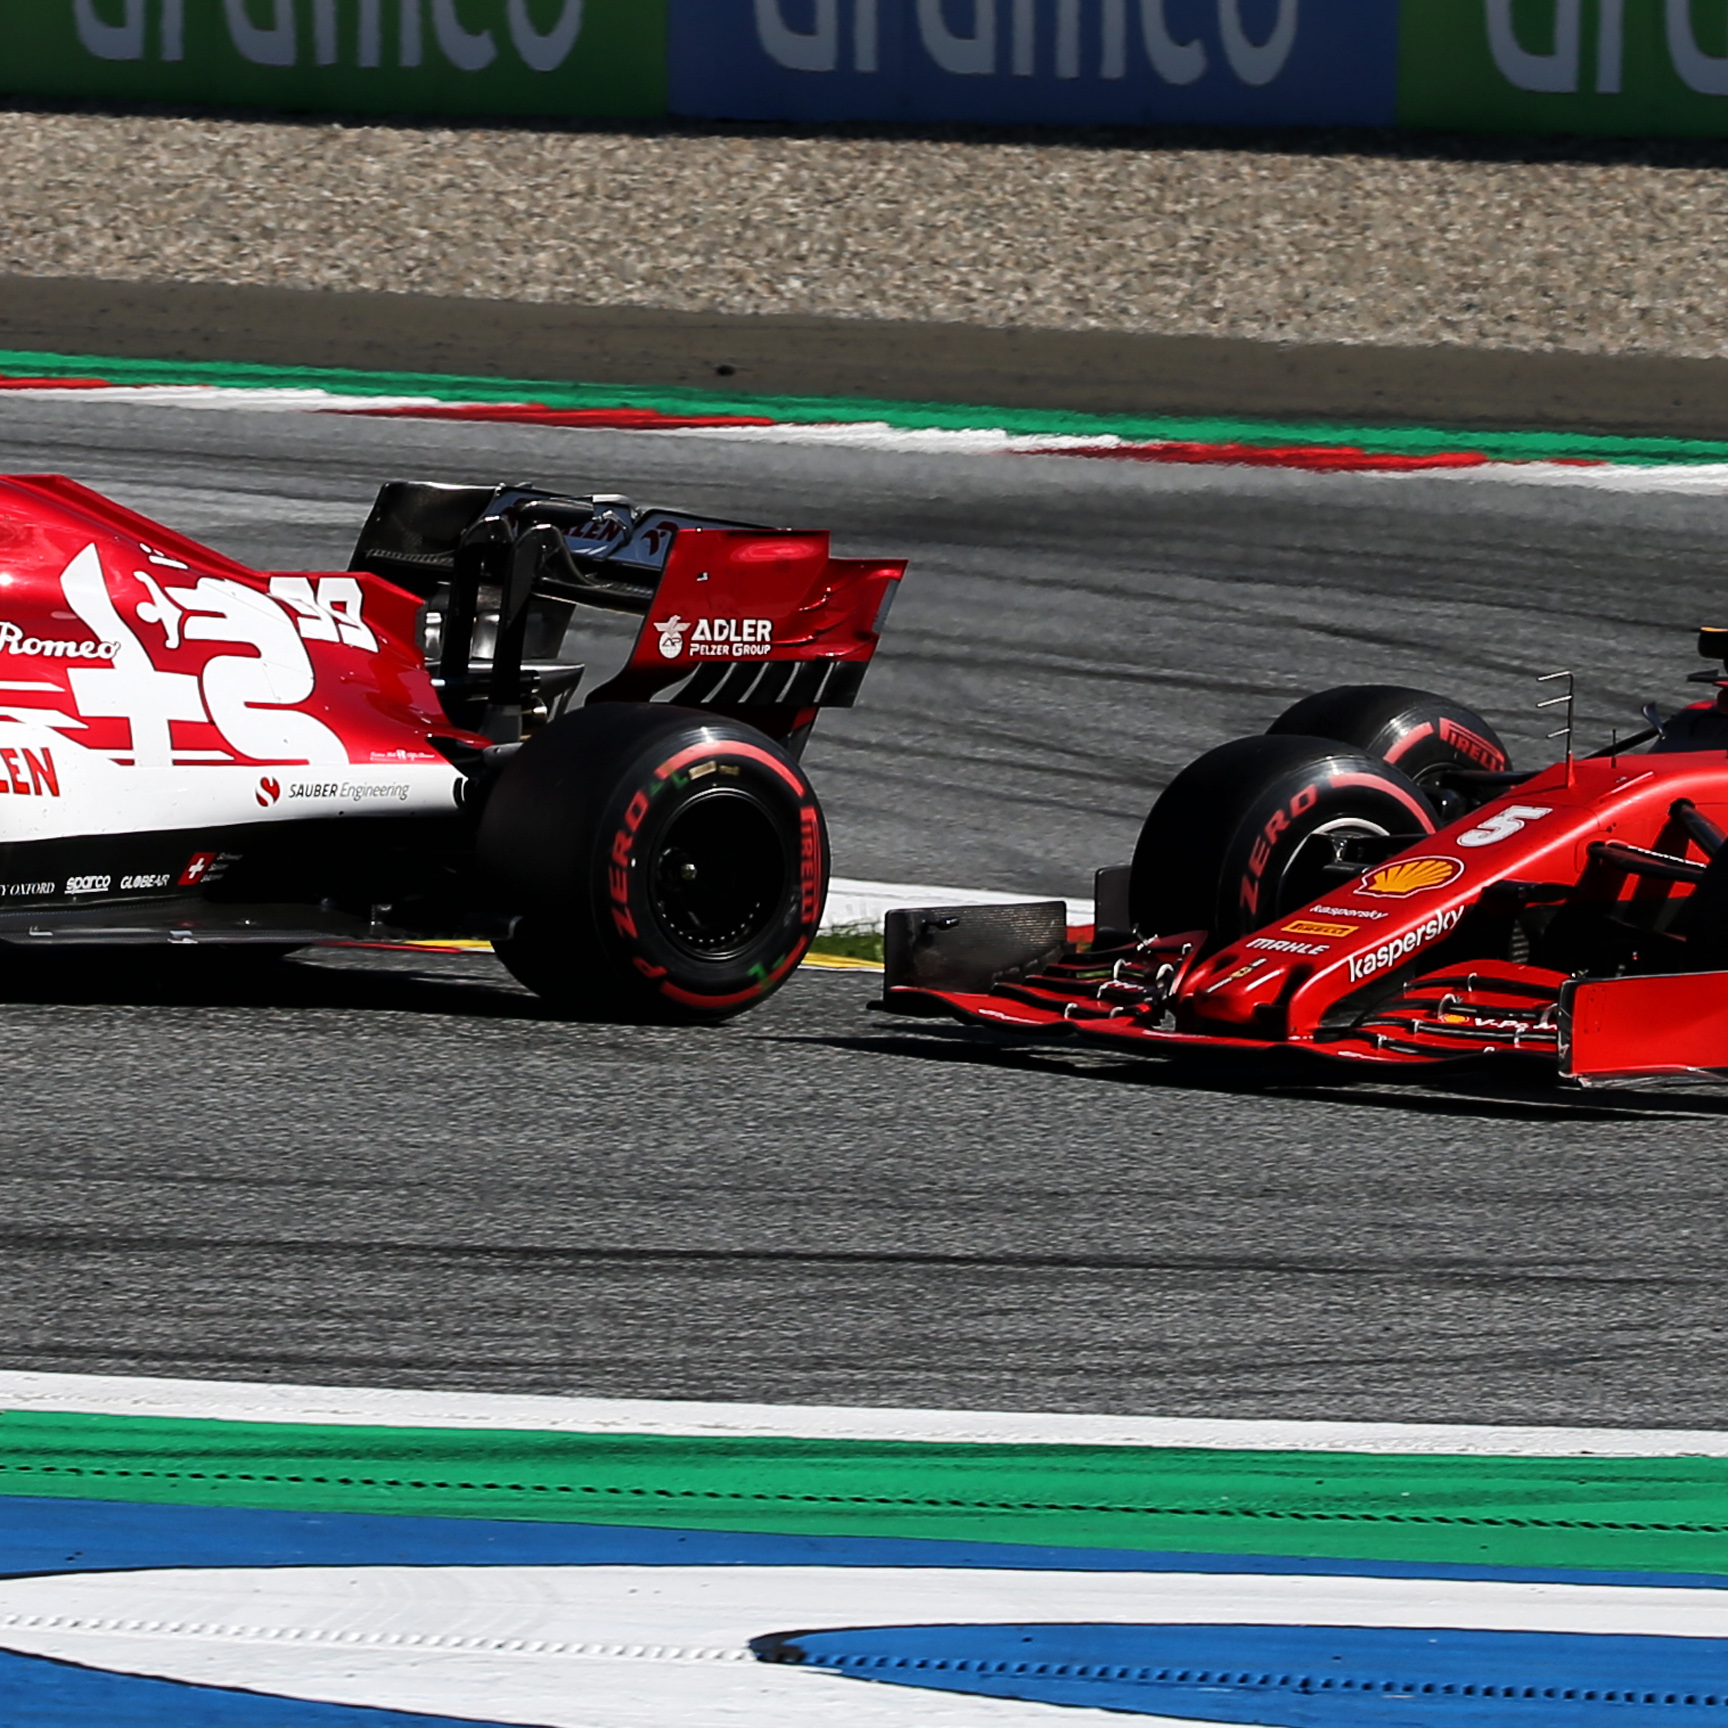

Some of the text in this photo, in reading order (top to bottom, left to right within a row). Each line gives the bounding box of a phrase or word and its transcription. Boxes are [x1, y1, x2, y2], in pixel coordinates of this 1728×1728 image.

[691, 619, 773, 642] ADLER
[690, 643, 771, 656] PELZER GROUP
[289, 781, 409, 800] SAUBER Engineering
[1457, 805, 1553, 848] 5
[1239, 783, 1319, 916] ZERO
[609, 789, 650, 939] ZERO
[800, 805, 821, 923] PIRELLI
[9, 882, 55, 895] OXFORD
[65, 875, 111, 891] sparco
[1246, 937, 1330, 954] MAHLE
[1348, 905, 1466, 982] kaspersky
